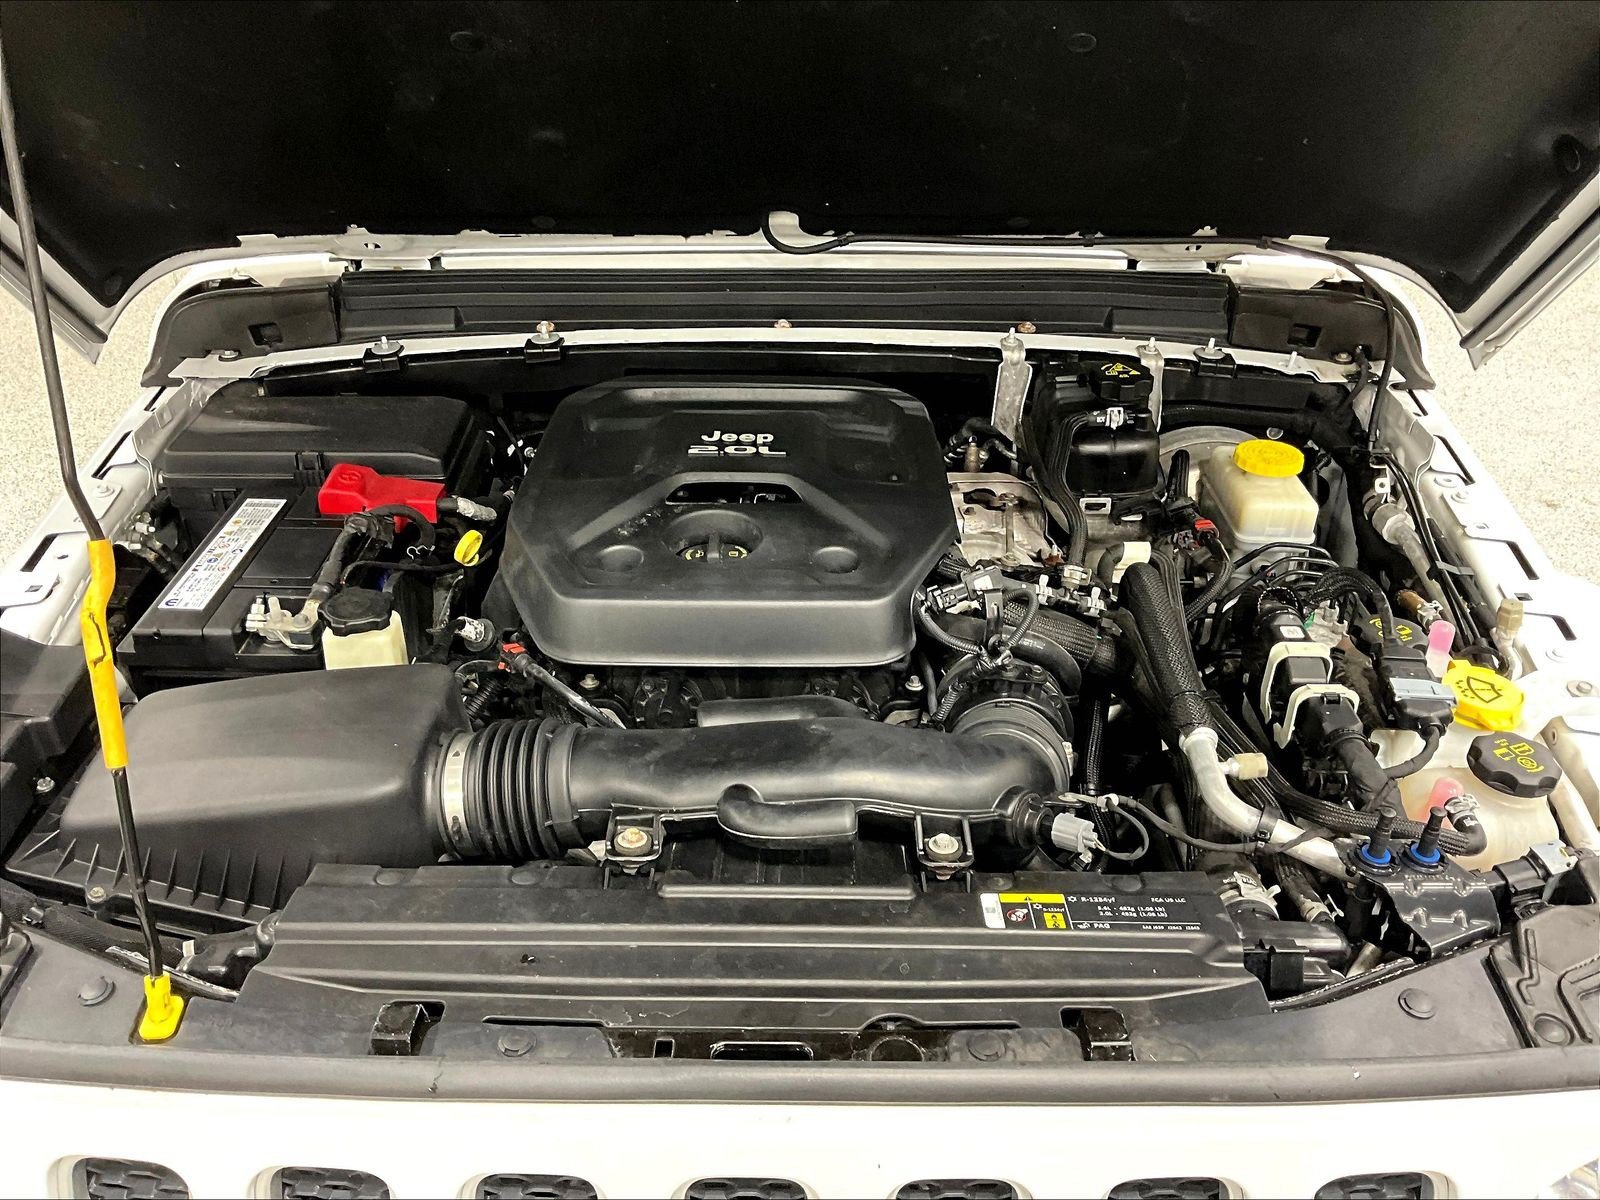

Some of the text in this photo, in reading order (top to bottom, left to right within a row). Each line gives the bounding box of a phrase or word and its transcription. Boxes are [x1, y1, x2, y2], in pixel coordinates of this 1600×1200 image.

[701, 430, 774, 444] Jeep
[688, 445, 787, 457] 2.0L
[1080, 896, 1116, 904] R-1234yf
